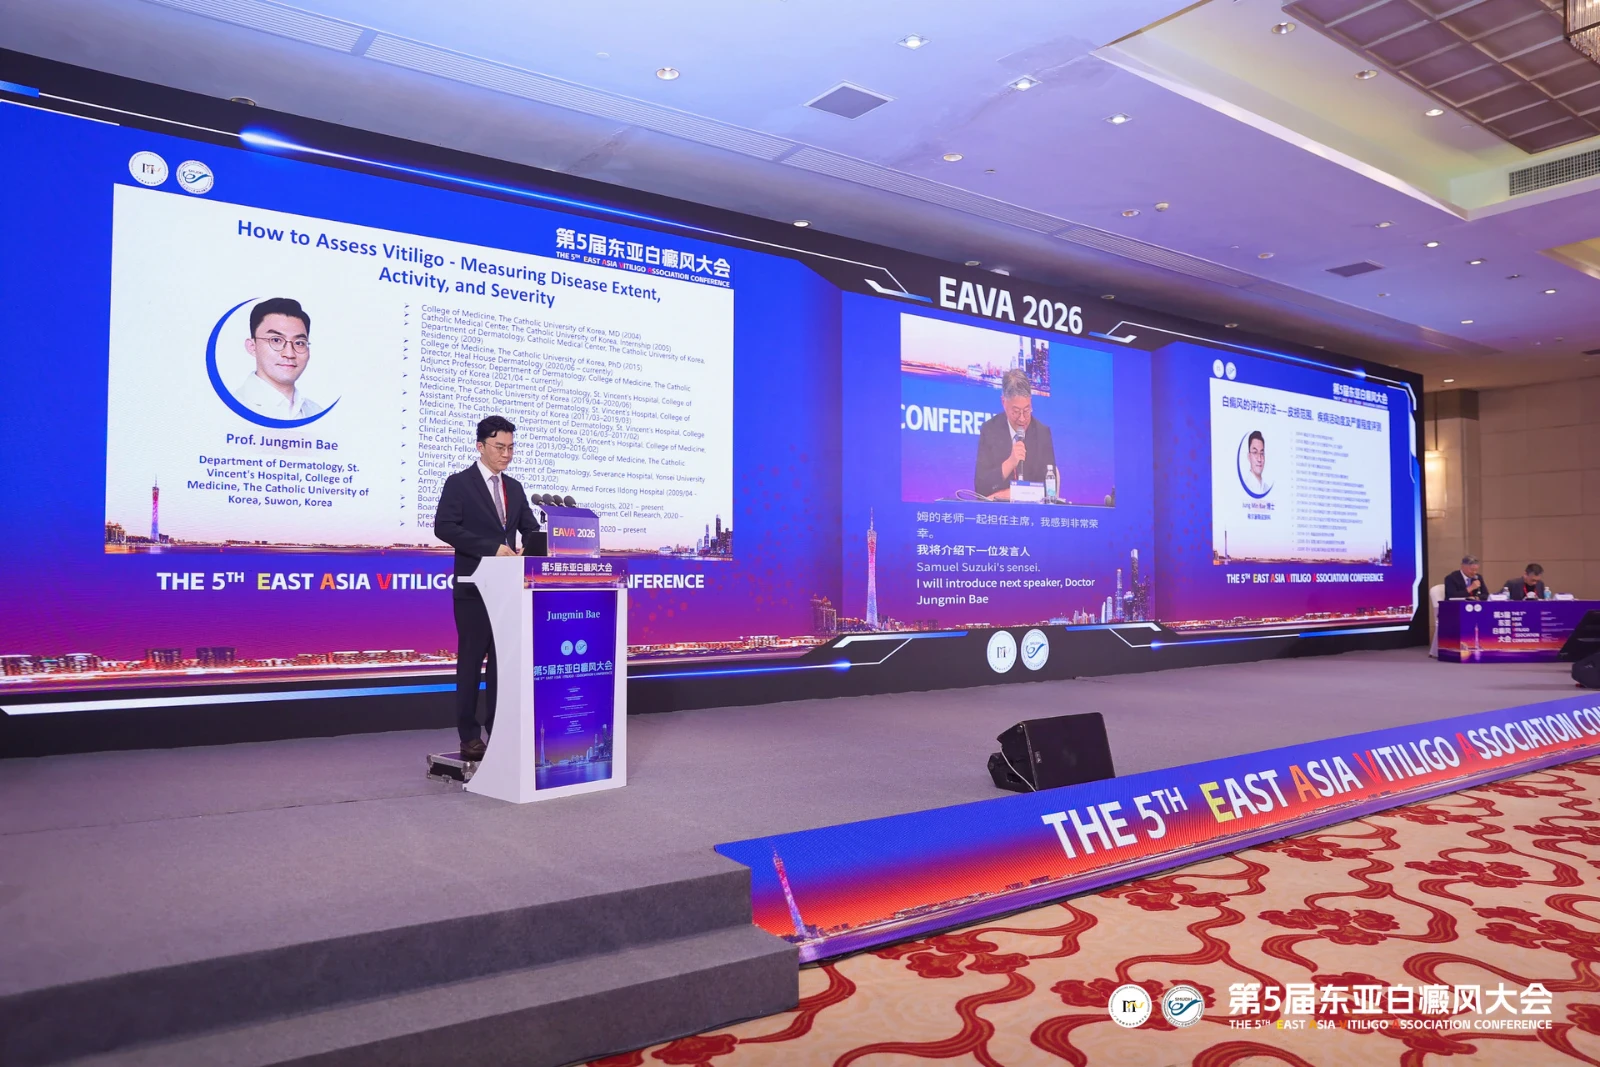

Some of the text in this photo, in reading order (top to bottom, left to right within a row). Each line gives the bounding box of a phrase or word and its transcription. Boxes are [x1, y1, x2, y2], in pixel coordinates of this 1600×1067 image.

[237, 219, 285, 242] How
[289, 229, 311, 246] to
[315, 232, 378, 257] Assess
[382, 242, 445, 269] Vitiligo
[460, 256, 547, 287] Measuring
[550, 270, 608, 293] Disease
[611, 280, 661, 304] Extent,
[556, 227, 731, 278] 第5届东亚白癜风大会
[556, 251, 731, 288] THE 5TH EAST ASIA VITILIGO ASSOCIATION CONFERENCE
[378, 266, 556, 309] Activity, and Severity
[939, 275, 1083, 335] EAVA 2026
[901, 403, 997, 435] ONFERE
[226, 433, 339, 451] Prof. Jungmin Bae
[198, 454, 360, 474] Department of Dermatology, St.
[206, 467, 354, 485] Vincent's Hospital, College of
[187, 479, 370, 498] Medicine, The Catholic University of
[227, 494, 333, 508] Korea, Suwon, Korea
[553, 527, 596, 538] EAVA 2026
[916, 528, 935, 539] 幸。
[916, 544, 1031, 557] 我将介绍下一位发言人
[916, 562, 1041, 572] Samuel Suzuki's sensei.
[156, 572, 205, 590] THE
[211, 571, 245, 591] 5TH
[257, 573, 314, 590] EAST
[319, 573, 371, 590] ASIA
[627, 574, 705, 589] NFERENCE
[916, 577, 1095, 590] I will introduce next speaker, Doctor
[1226, 573, 1240, 583] THE
[1241, 573, 1251, 583] 5TH
[1252, 574, 1270, 583] EAST
[1270, 574, 1285, 583] ASIA
[1312, 573, 1349, 583] ASSOCIATION
[1349, 573, 1384, 583] CONFERENCE
[916, 594, 989, 607] Jungmin Bae
[546, 609, 601, 622] Jungmin Bae
[1041, 800, 1139, 859] THE
[1132, 786, 1188, 839] 5TH
[1198, 769, 1289, 824] EAST
[1288, 755, 1364, 803] ASIA
[1352, 736, 1461, 784] VITILIGO
[1455, 713, 1584, 763] ASSOCIATION
